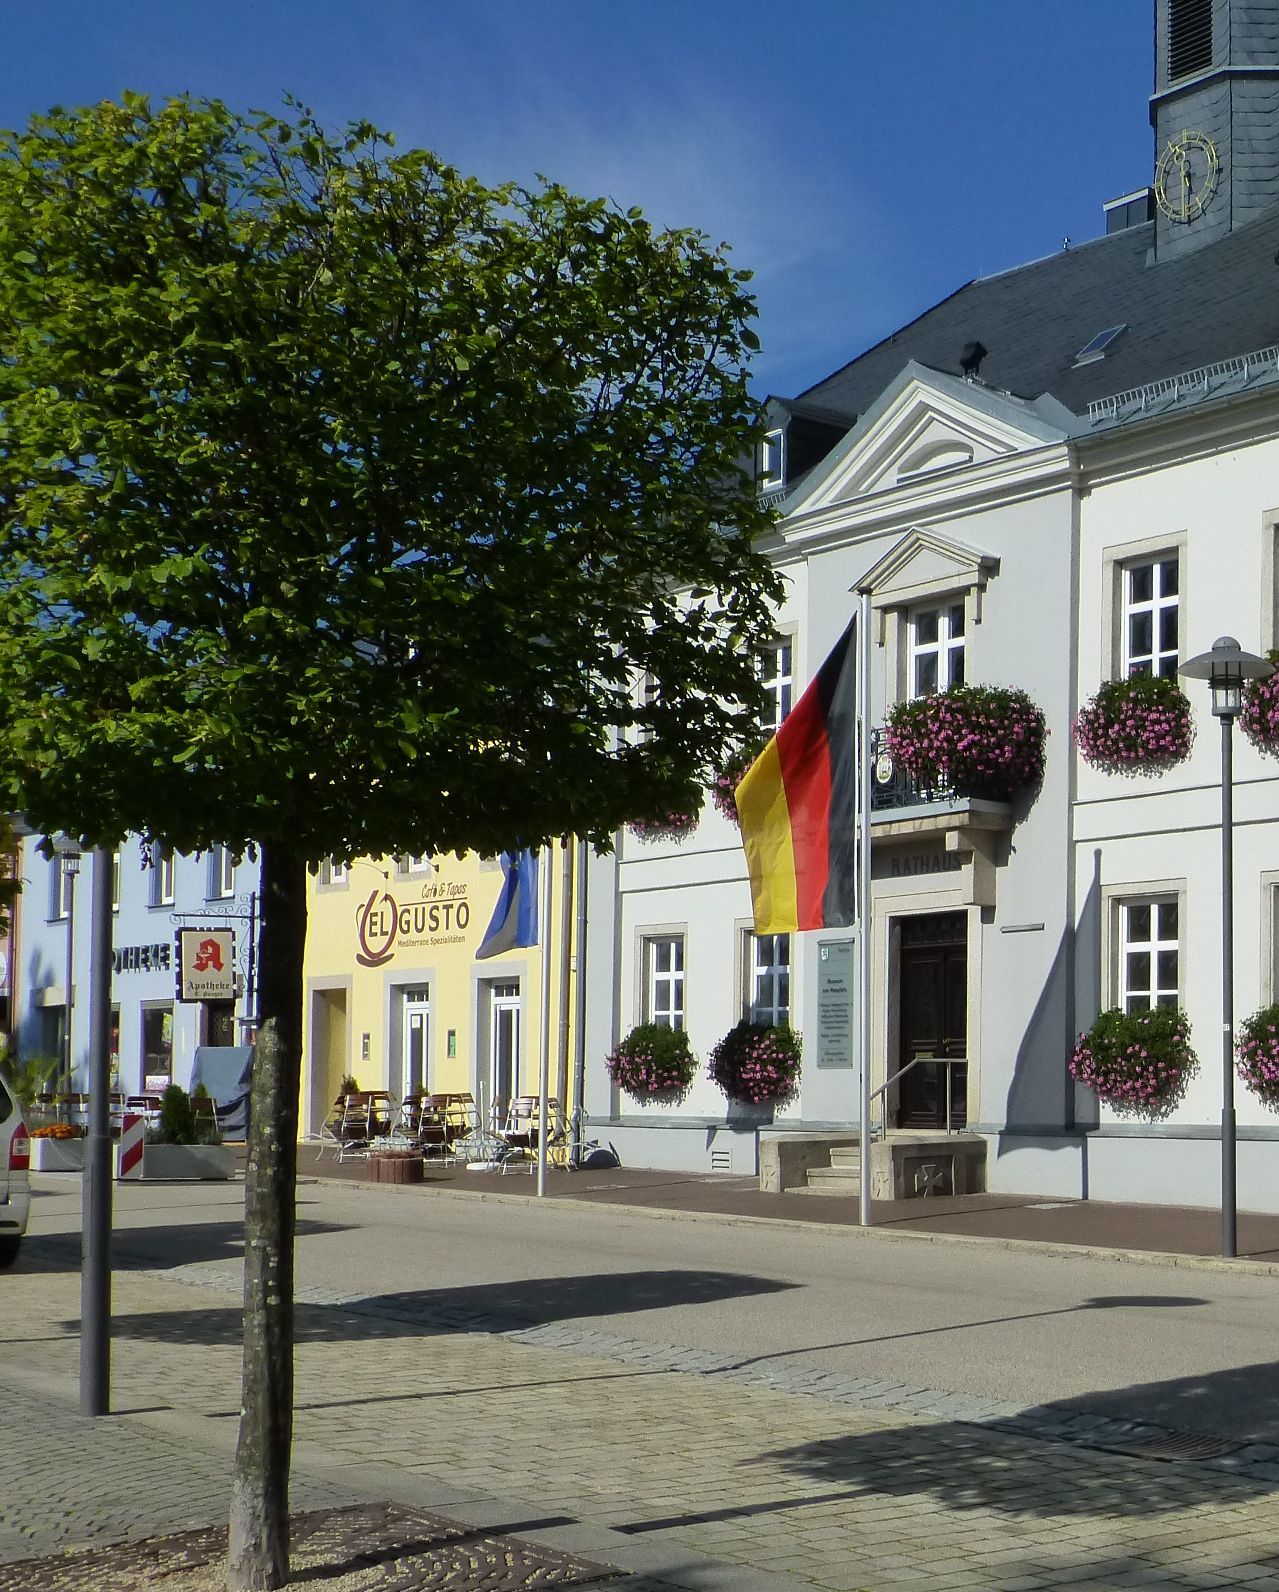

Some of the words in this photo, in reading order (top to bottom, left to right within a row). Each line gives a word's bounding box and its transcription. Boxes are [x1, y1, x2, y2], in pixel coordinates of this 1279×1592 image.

[891, 852, 961, 876] RATHAUS
[438, 883, 445, 896] &
[446, 882, 467, 899] Tapas
[369, 911, 389, 937] EL
[399, 902, 469, 934] GUSTO
[187, 980, 230, 991] Apotheke
